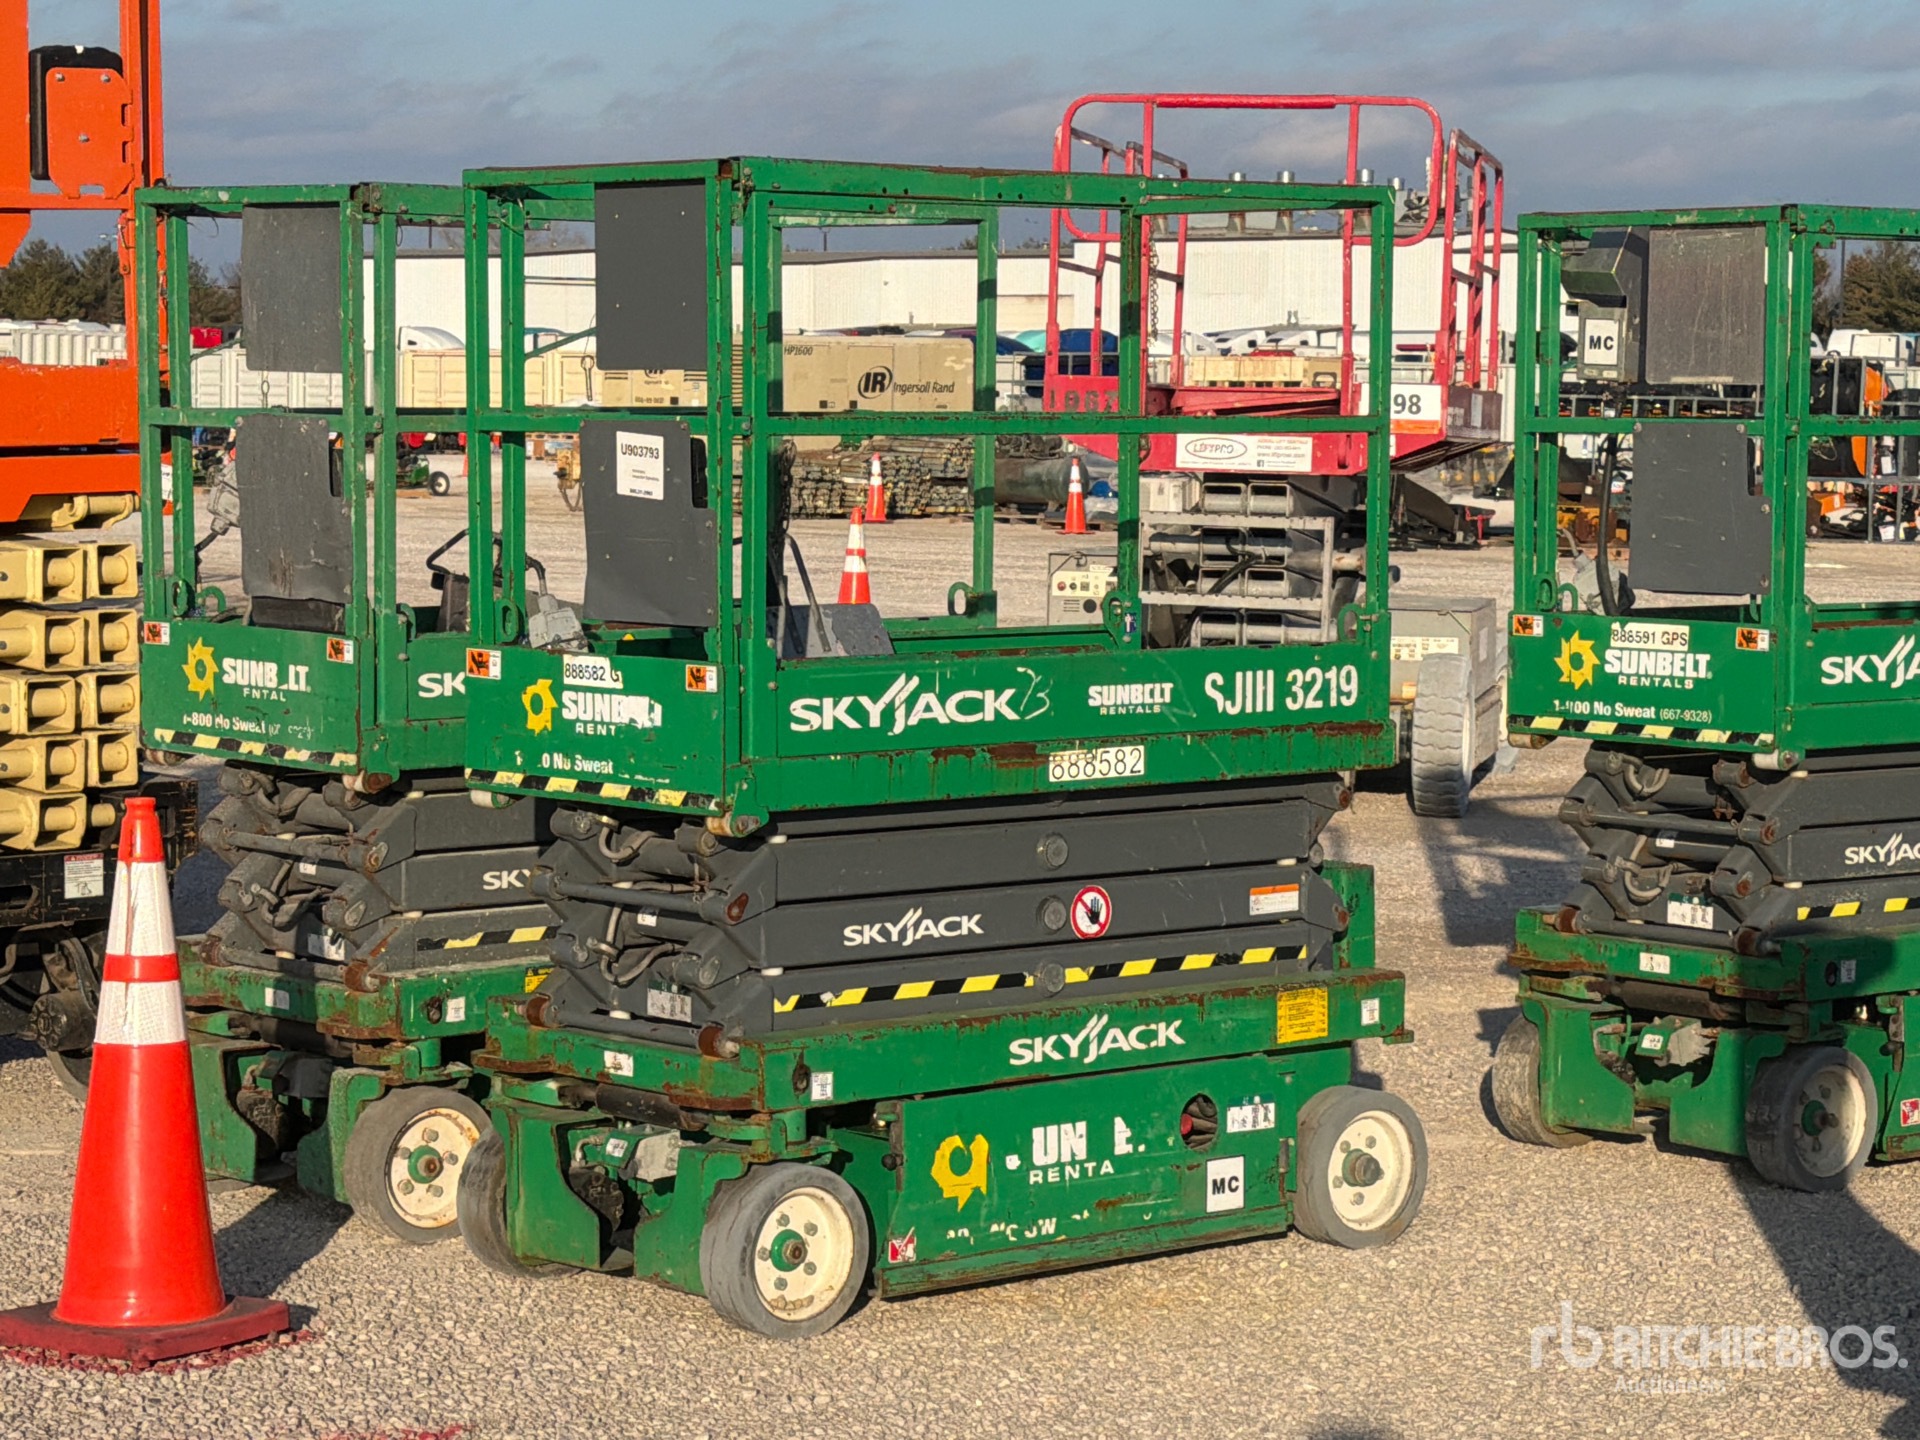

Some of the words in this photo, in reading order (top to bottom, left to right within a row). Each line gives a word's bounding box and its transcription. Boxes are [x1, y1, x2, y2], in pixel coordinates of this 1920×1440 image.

[1589, 334, 1615, 351] MC
[864, 371, 886, 393] IR
[893, 382, 930, 395] Ingersoll
[933, 380, 955, 393] Rand
[621, 443, 659, 459] U903793
[1661, 631, 1688, 646] GPS
[222, 657, 309, 691] SUNBLT
[565, 663, 606, 681] 888582
[1604, 649, 1711, 678] SUNBELT
[1088, 682, 1174, 706] SUNBELT
[1285, 665, 1359, 711] 3219
[1618, 675, 1694, 689] RENTALS
[790, 673, 1020, 735] SKYJACK
[1100, 704, 1161, 716] RENTALS
[1593, 701, 1611, 716] No
[1614, 702, 1656, 719] Sweat
[1659, 709, 1713, 724] (667-9328)
[574, 754, 614, 775] Sweat
[843, 906, 984, 946] SKYJACK
[1009, 1013, 1186, 1065] SKYJACK
[1212, 1175, 1240, 1196] MC
